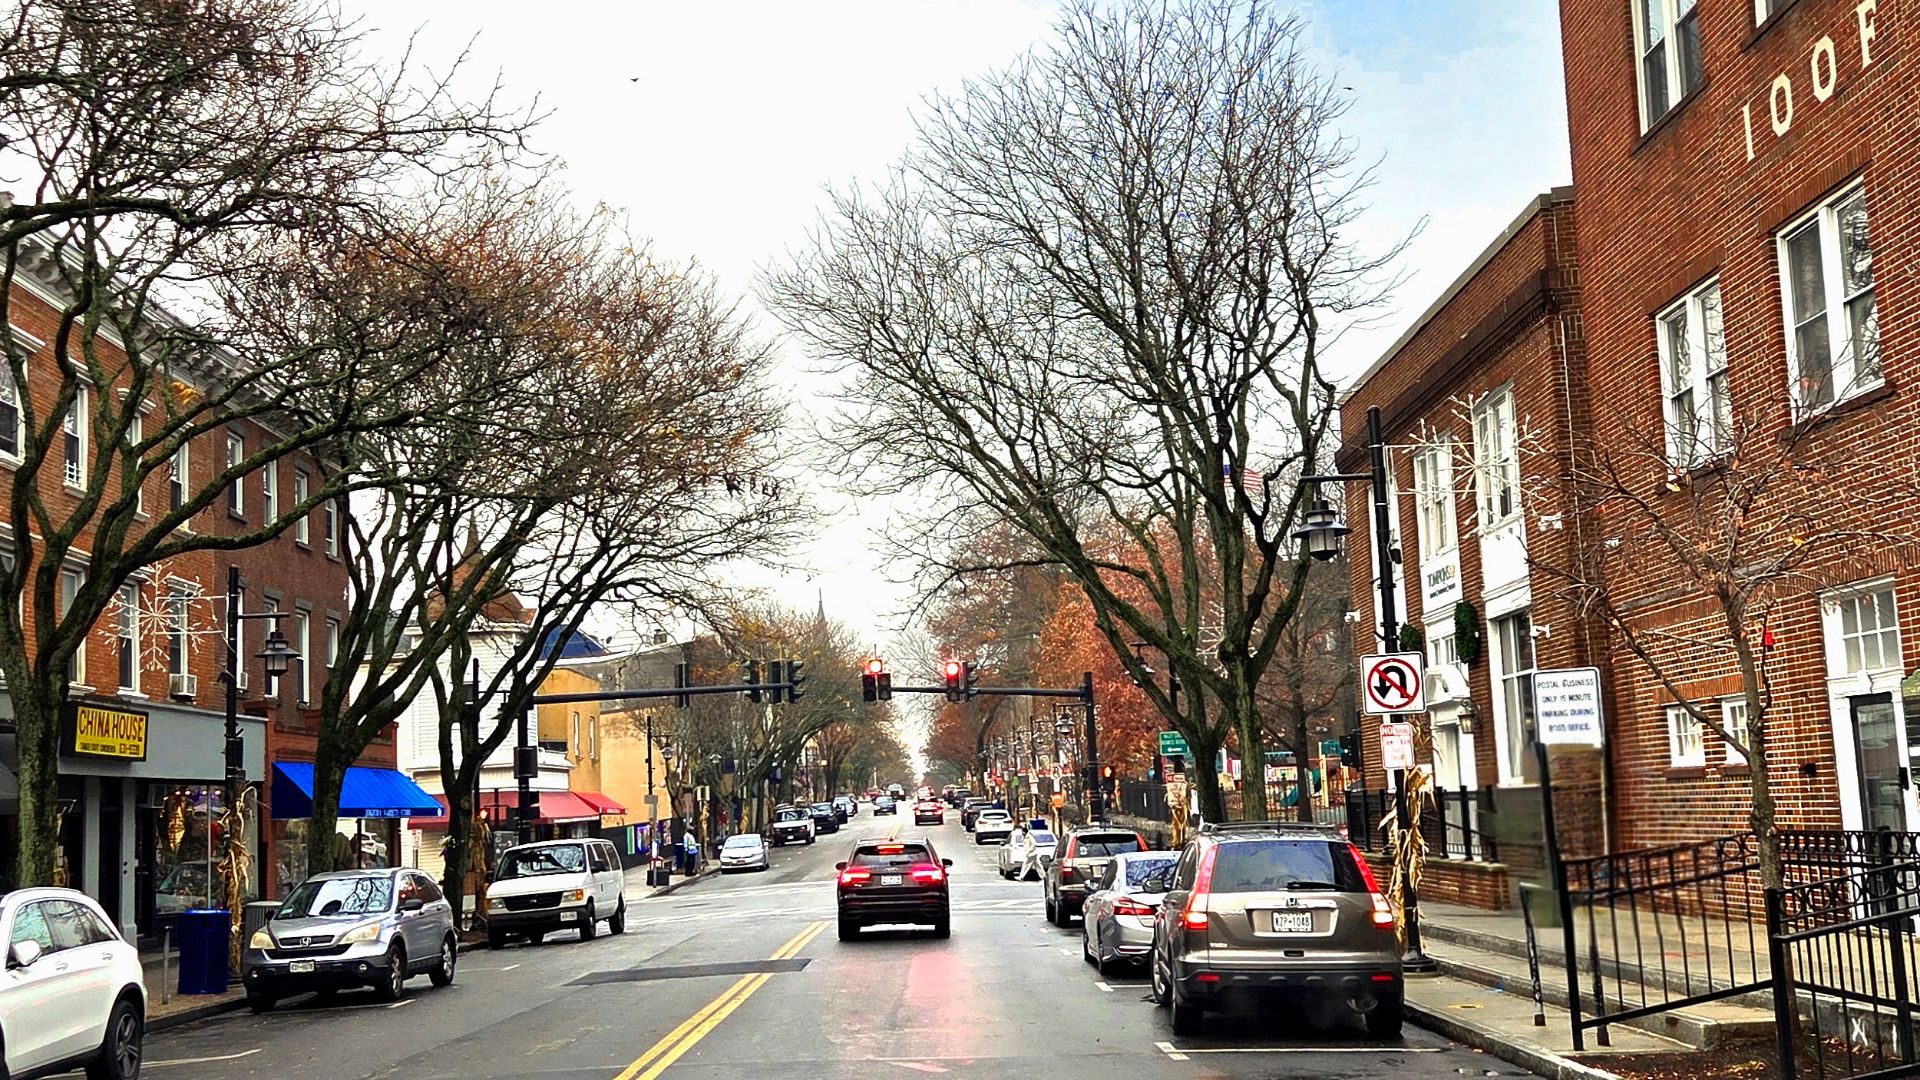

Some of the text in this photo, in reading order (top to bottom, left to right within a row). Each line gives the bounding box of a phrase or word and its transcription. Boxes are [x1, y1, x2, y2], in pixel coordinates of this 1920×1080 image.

[1562, 679, 1594, 687] BUSINESS
[1542, 695, 1557, 703] ONLY
[1569, 693, 1592, 701] MINUTE
[79, 709, 143, 742] CHINA HOUSE
